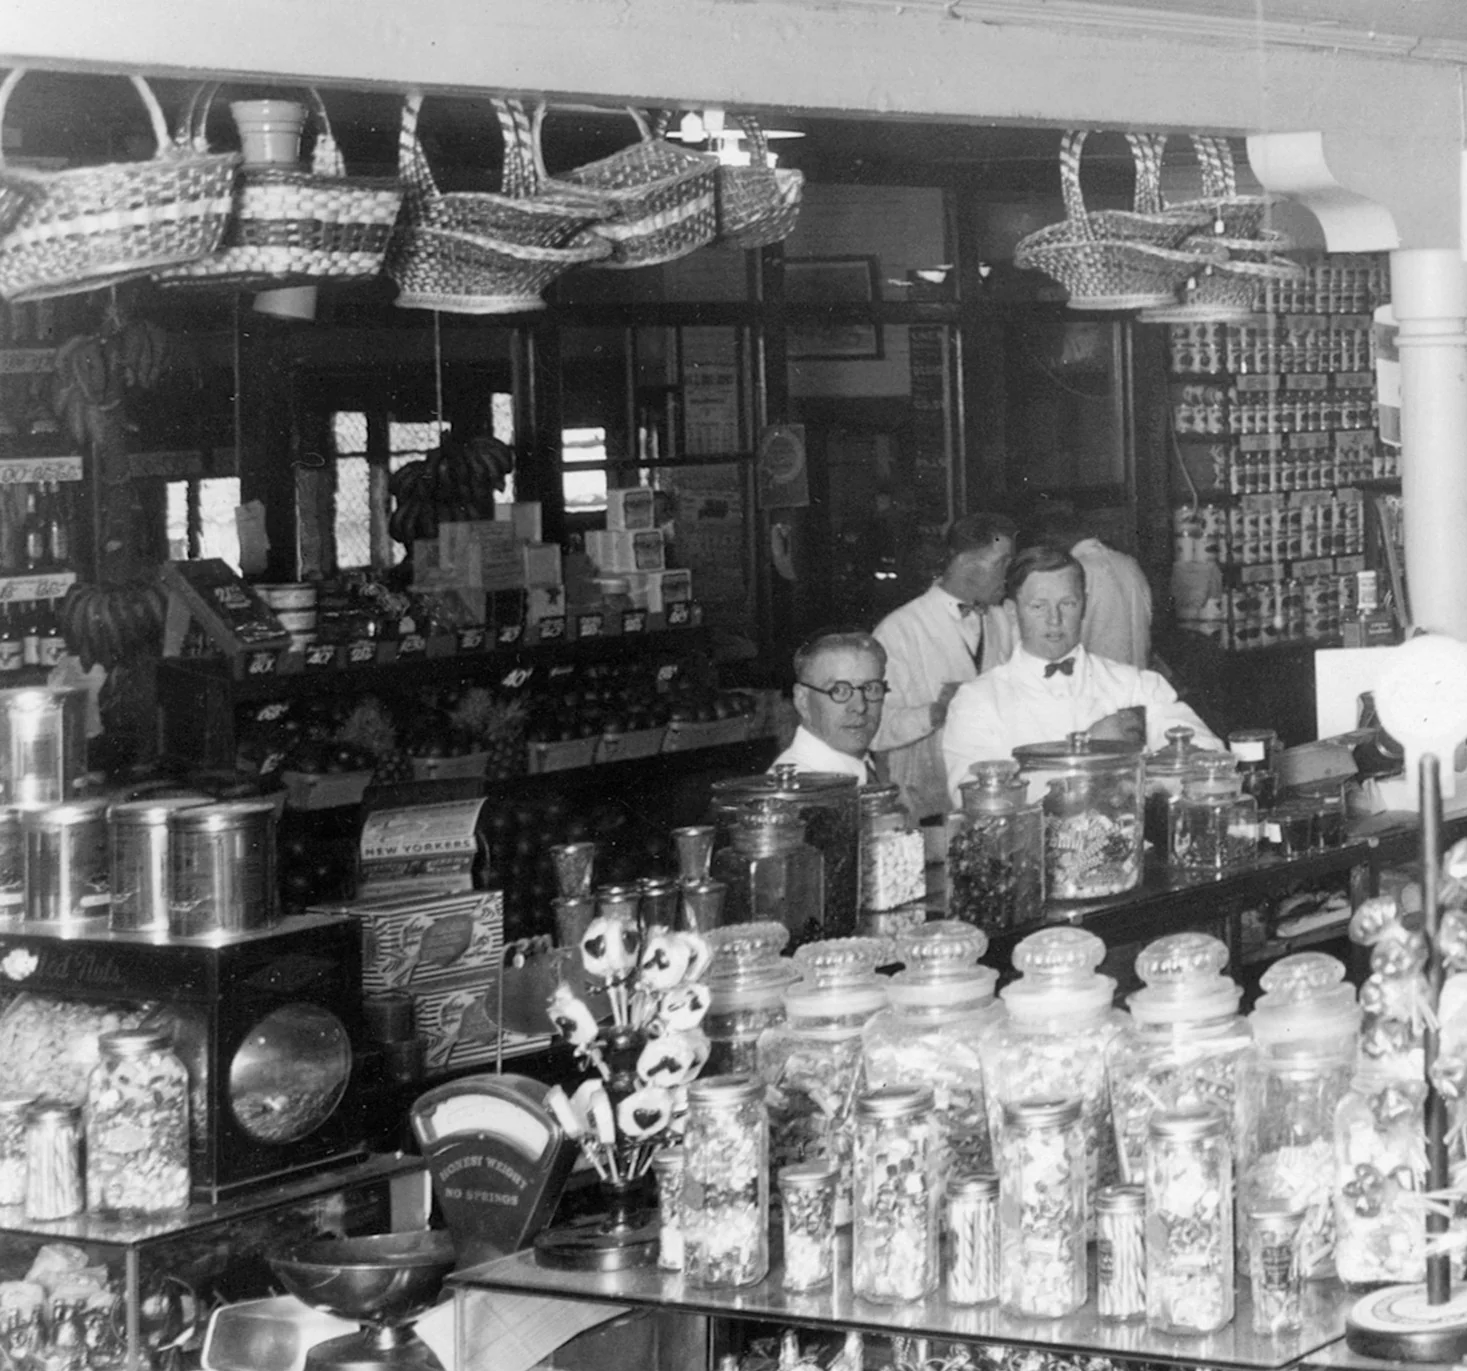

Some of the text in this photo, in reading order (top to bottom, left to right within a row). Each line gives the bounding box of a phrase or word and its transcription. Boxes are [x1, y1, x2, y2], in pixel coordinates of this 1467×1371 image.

[364, 838, 471, 858] NEW YORKERS
[439, 1155, 529, 1191] HONEST WEIGHT
[445, 1187, 520, 1206] NO SPRINGS
